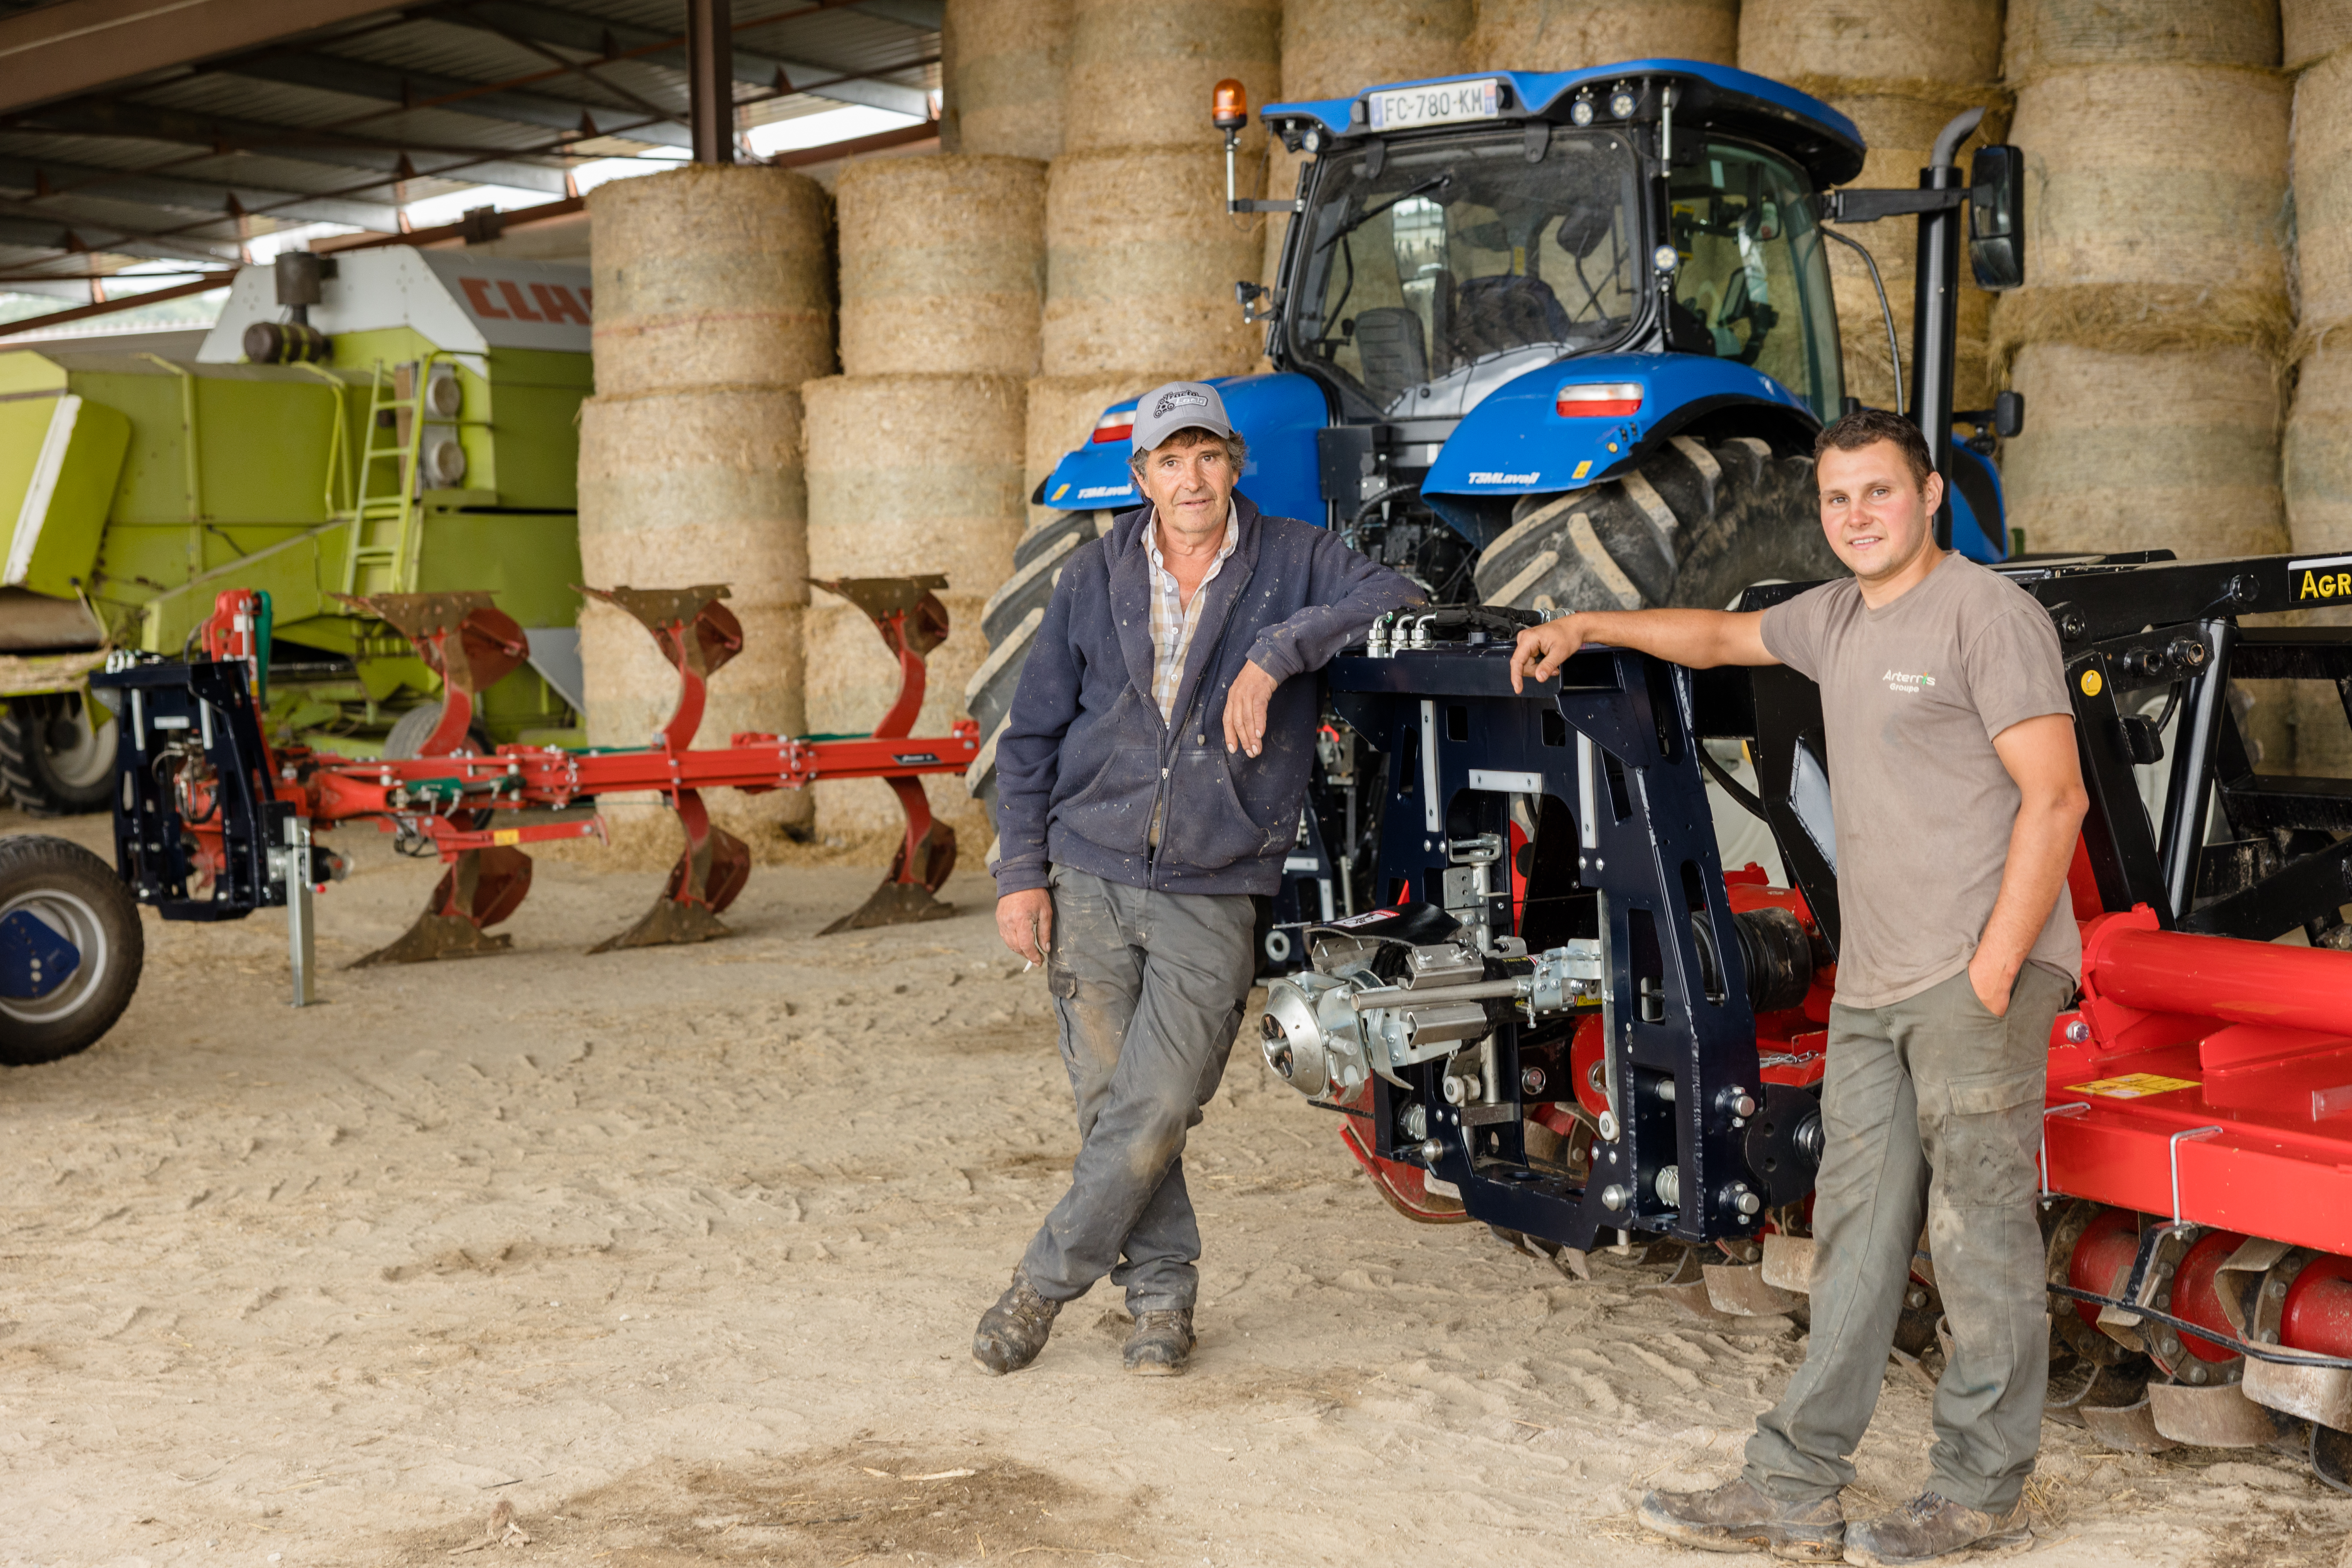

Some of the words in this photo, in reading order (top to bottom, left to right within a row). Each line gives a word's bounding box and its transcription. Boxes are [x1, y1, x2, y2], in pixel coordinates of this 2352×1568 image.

[1384, 88, 1482, 122] FC-780-KM
[457, 276, 593, 326] CLA
[1164, 390, 1198, 400] Tracto
[1882, 669, 1936, 686] Arterris
[1890, 683, 1920, 694] Groupe
